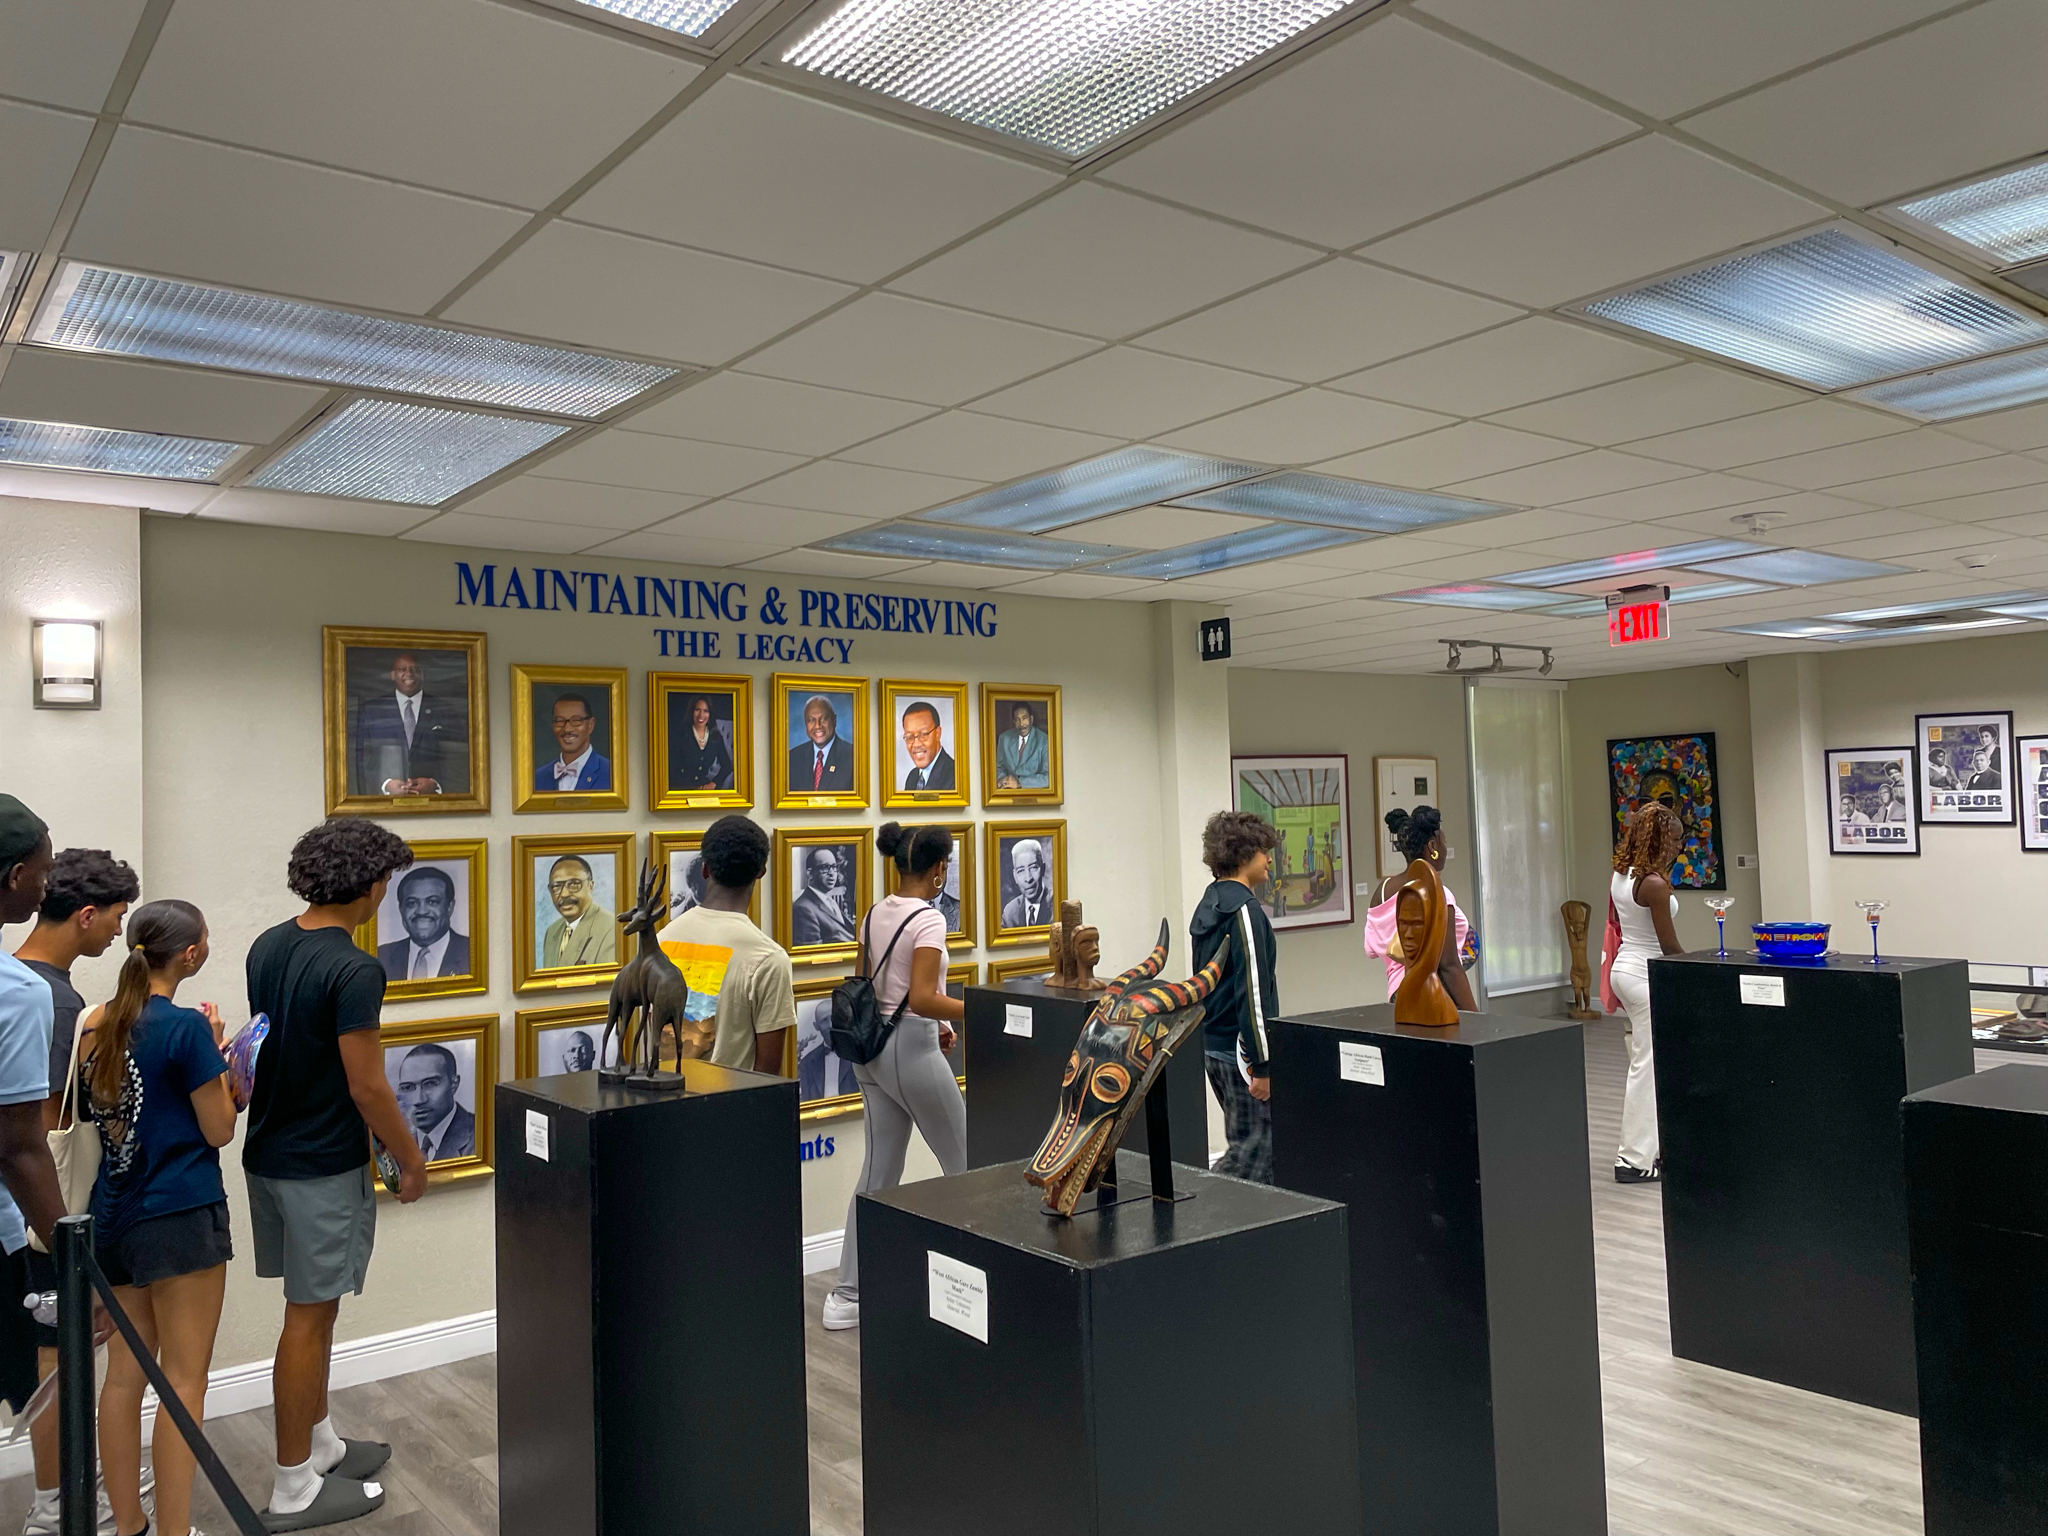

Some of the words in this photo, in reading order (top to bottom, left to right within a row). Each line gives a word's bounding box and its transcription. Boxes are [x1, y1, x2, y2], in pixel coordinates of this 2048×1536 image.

[454, 562, 748, 622] MAINTAINING
[760, 586, 788, 626] &
[798, 589, 998, 638] PRESERVING
[1618, 602, 1660, 643] EXIT
[653, 629, 721, 659] THE
[737, 633, 854, 664] LEGACY
[1932, 795, 2002, 805] LABOR
[1841, 827, 1906, 838] LABOR
